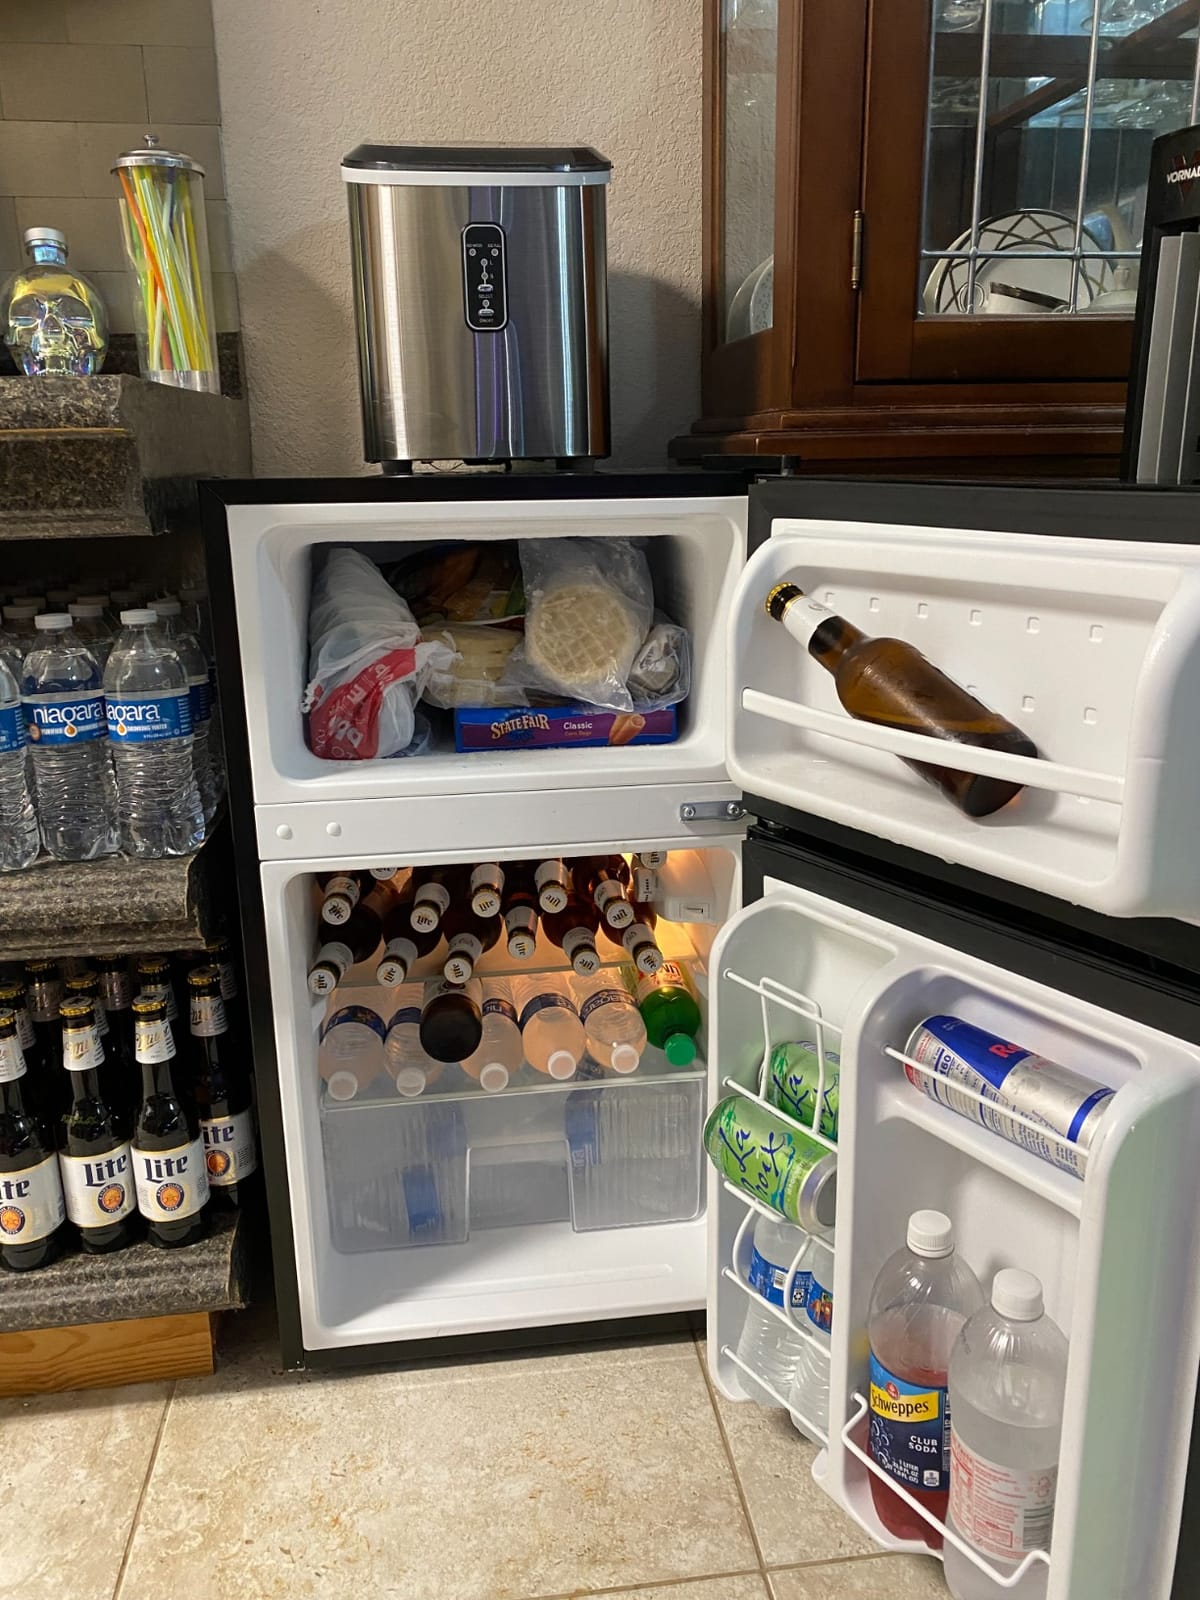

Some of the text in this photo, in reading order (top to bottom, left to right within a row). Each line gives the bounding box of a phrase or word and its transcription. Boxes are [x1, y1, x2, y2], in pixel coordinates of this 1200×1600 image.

[33, 702, 104, 724] niagara
[563, 721, 593, 731] Classic
[478, 900, 495, 912] Lite
[544, 894, 562, 908] Lite
[328, 904, 344, 920] Lite
[612, 908, 629, 922] Lite
[416, 915, 433, 926] Lite
[515, 942, 526, 956] Lite
[578, 958, 594, 971] Lite
[642, 954, 657, 969] Lite
[383, 967, 397, 983] Lite
[453, 963, 464, 979] Lite
[317, 974, 328, 989] Lite
[940, 1055, 952, 1076] 160
[202, 1126, 234, 1150] ite
[719, 1127, 756, 1173] La
[82, 1154, 127, 1187] Lite
[144, 1156, 188, 1184] Lite
[871, 1390, 930, 1418] Schweppes
[908, 1442, 938, 1454] SODA
[910, 1435, 938, 1446] CLUB
